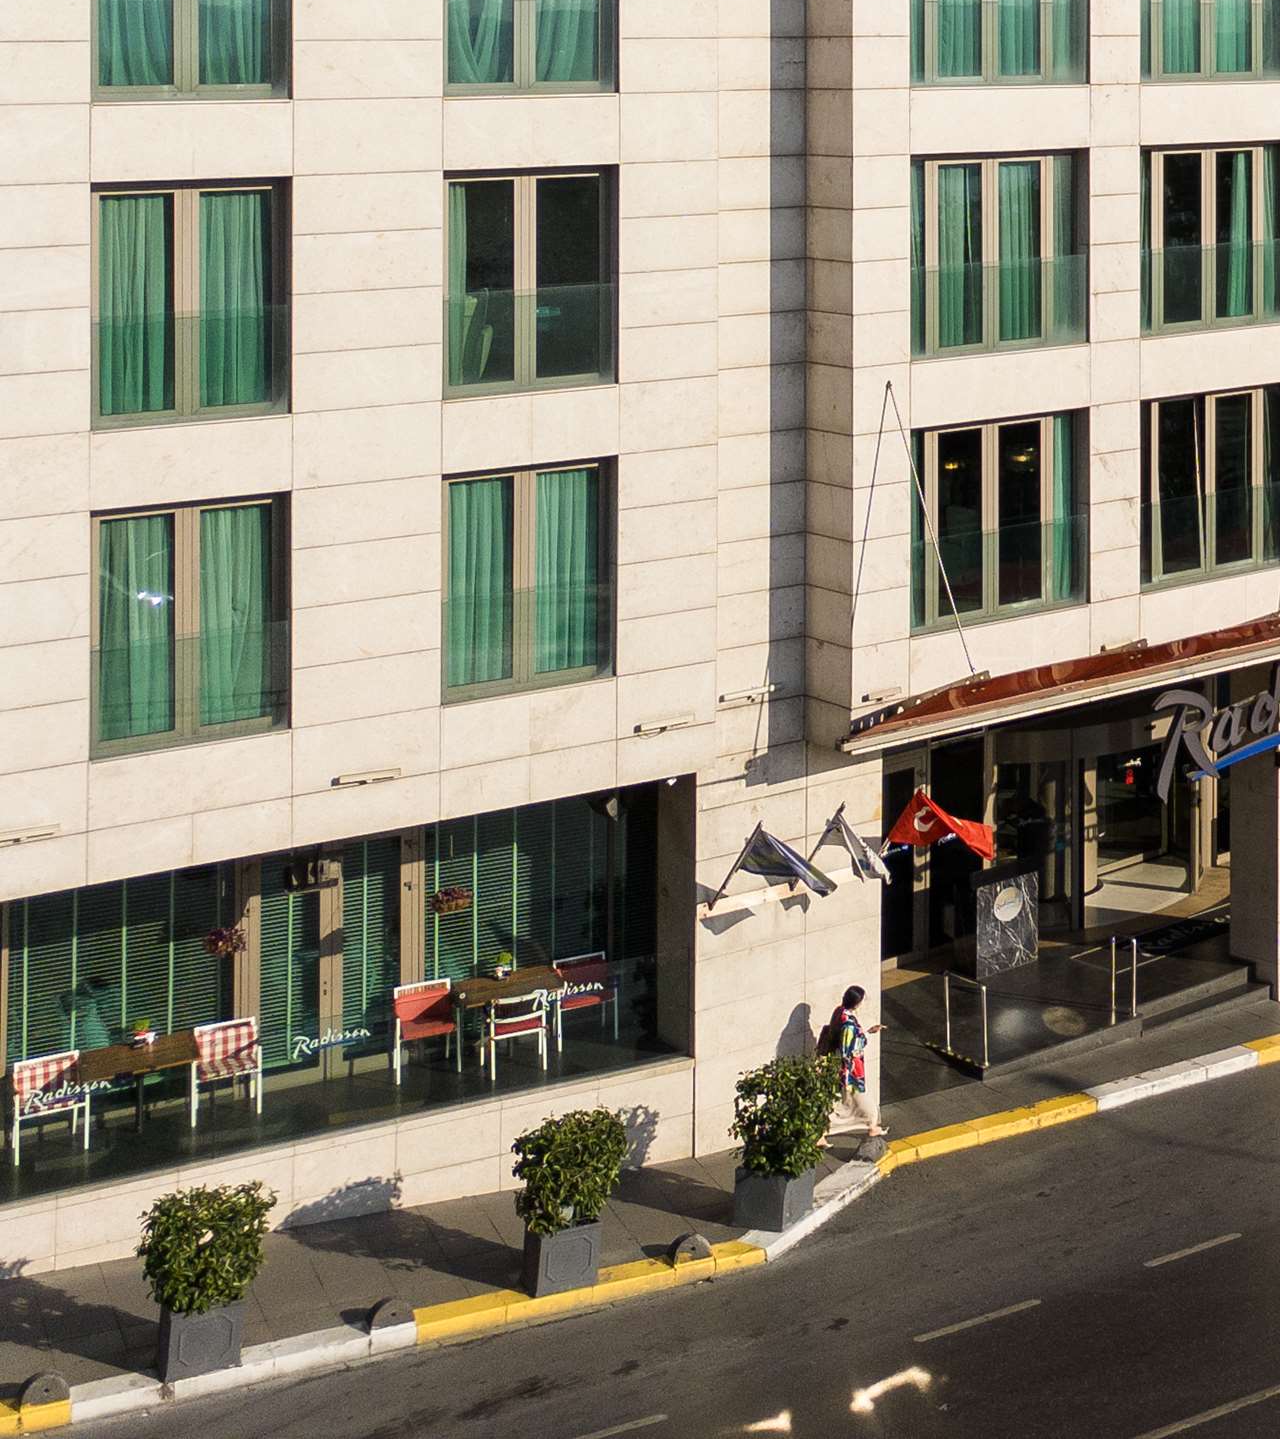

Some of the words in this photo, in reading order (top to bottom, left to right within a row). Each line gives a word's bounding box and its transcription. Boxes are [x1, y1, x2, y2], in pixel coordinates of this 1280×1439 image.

[531, 981, 604, 1012] Radisson
[292, 1027, 371, 1060] Radisson
[24, 1080, 112, 1114] Radisson
